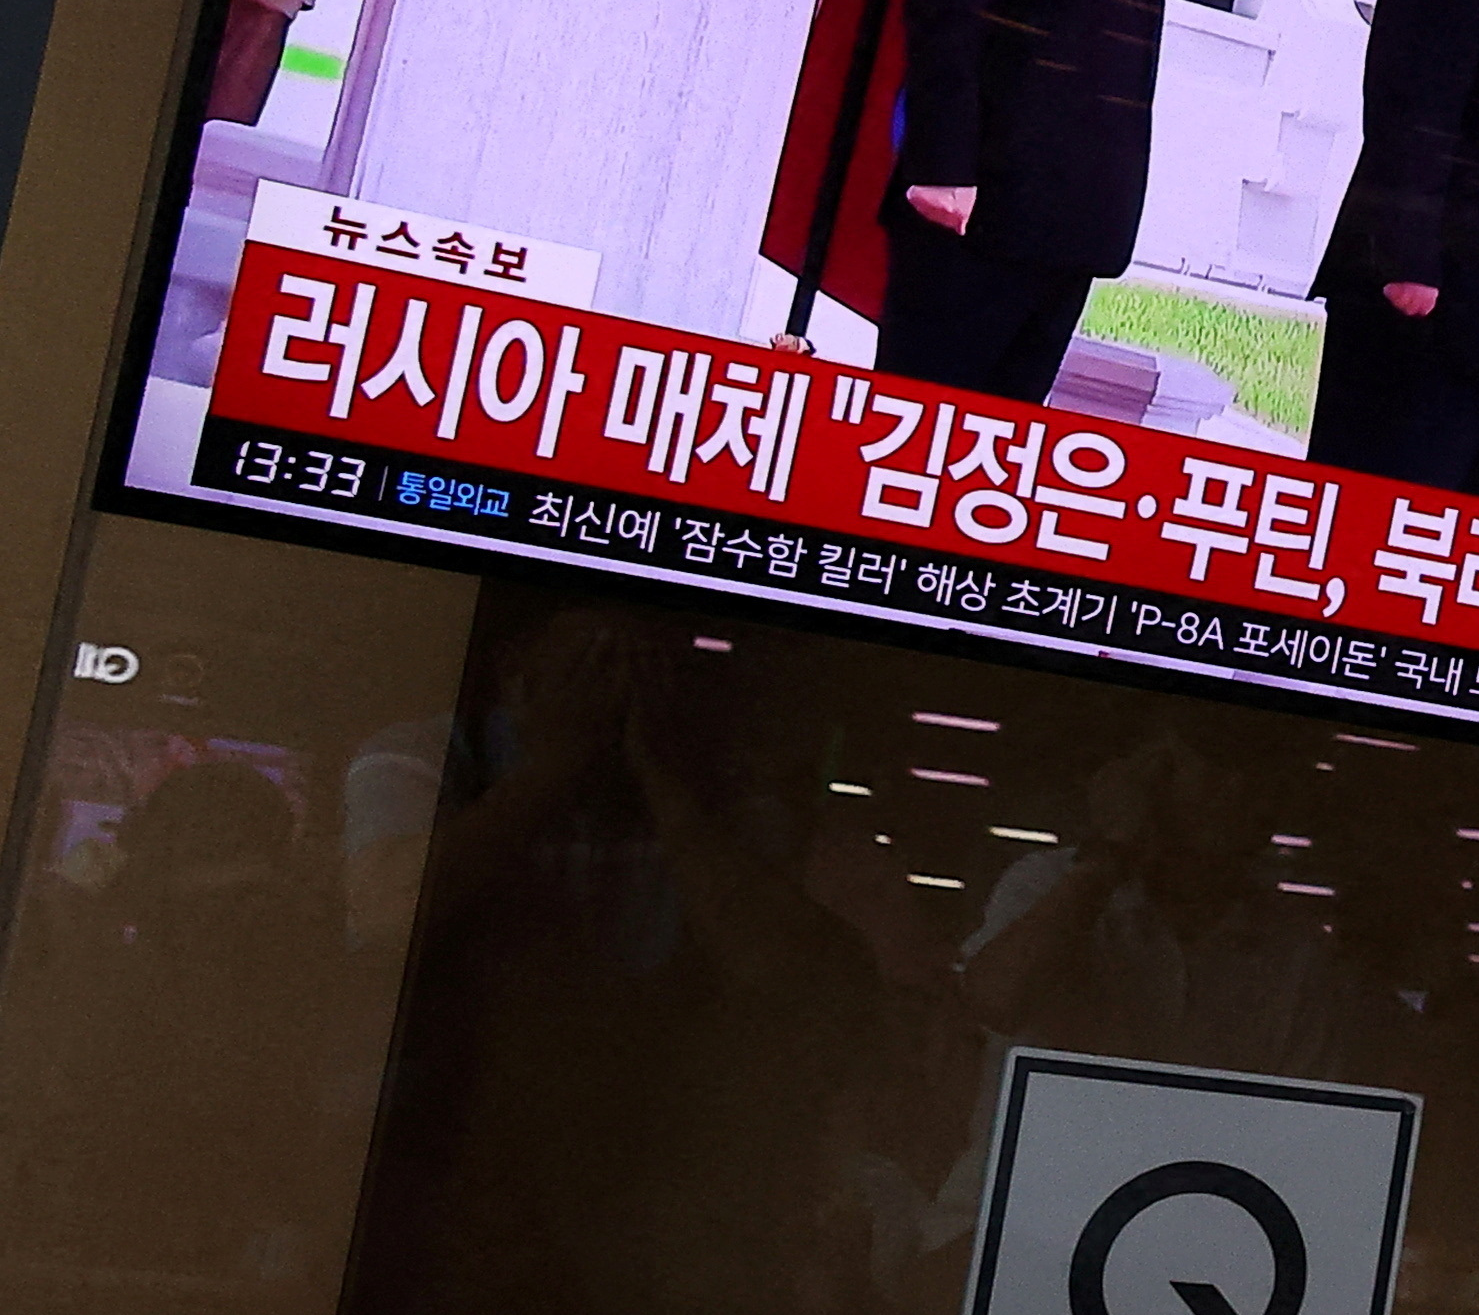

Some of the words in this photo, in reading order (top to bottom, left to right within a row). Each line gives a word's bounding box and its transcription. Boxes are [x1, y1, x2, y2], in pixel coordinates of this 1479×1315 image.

[323, 205, 527, 283] 뉴스속보
[261, 275, 585, 460] 러시아
[603, 348, 810, 503] 매체
[235, 440, 366, 498] 13:33
[395, 471, 509, 519] 통일외교
[529, 491, 660, 549] 최신예
[674, 517, 809, 577] '잠수함
[819, 542, 908, 594] 킬러'
[917, 562, 995, 612] 해상
[1001, 579, 1119, 634] 초계기
[1130, 601, 1225, 652] 'P-8A
[1233, 621, 1388, 681] 포세이돈'
[1394, 648, 1464, 696] 국내
